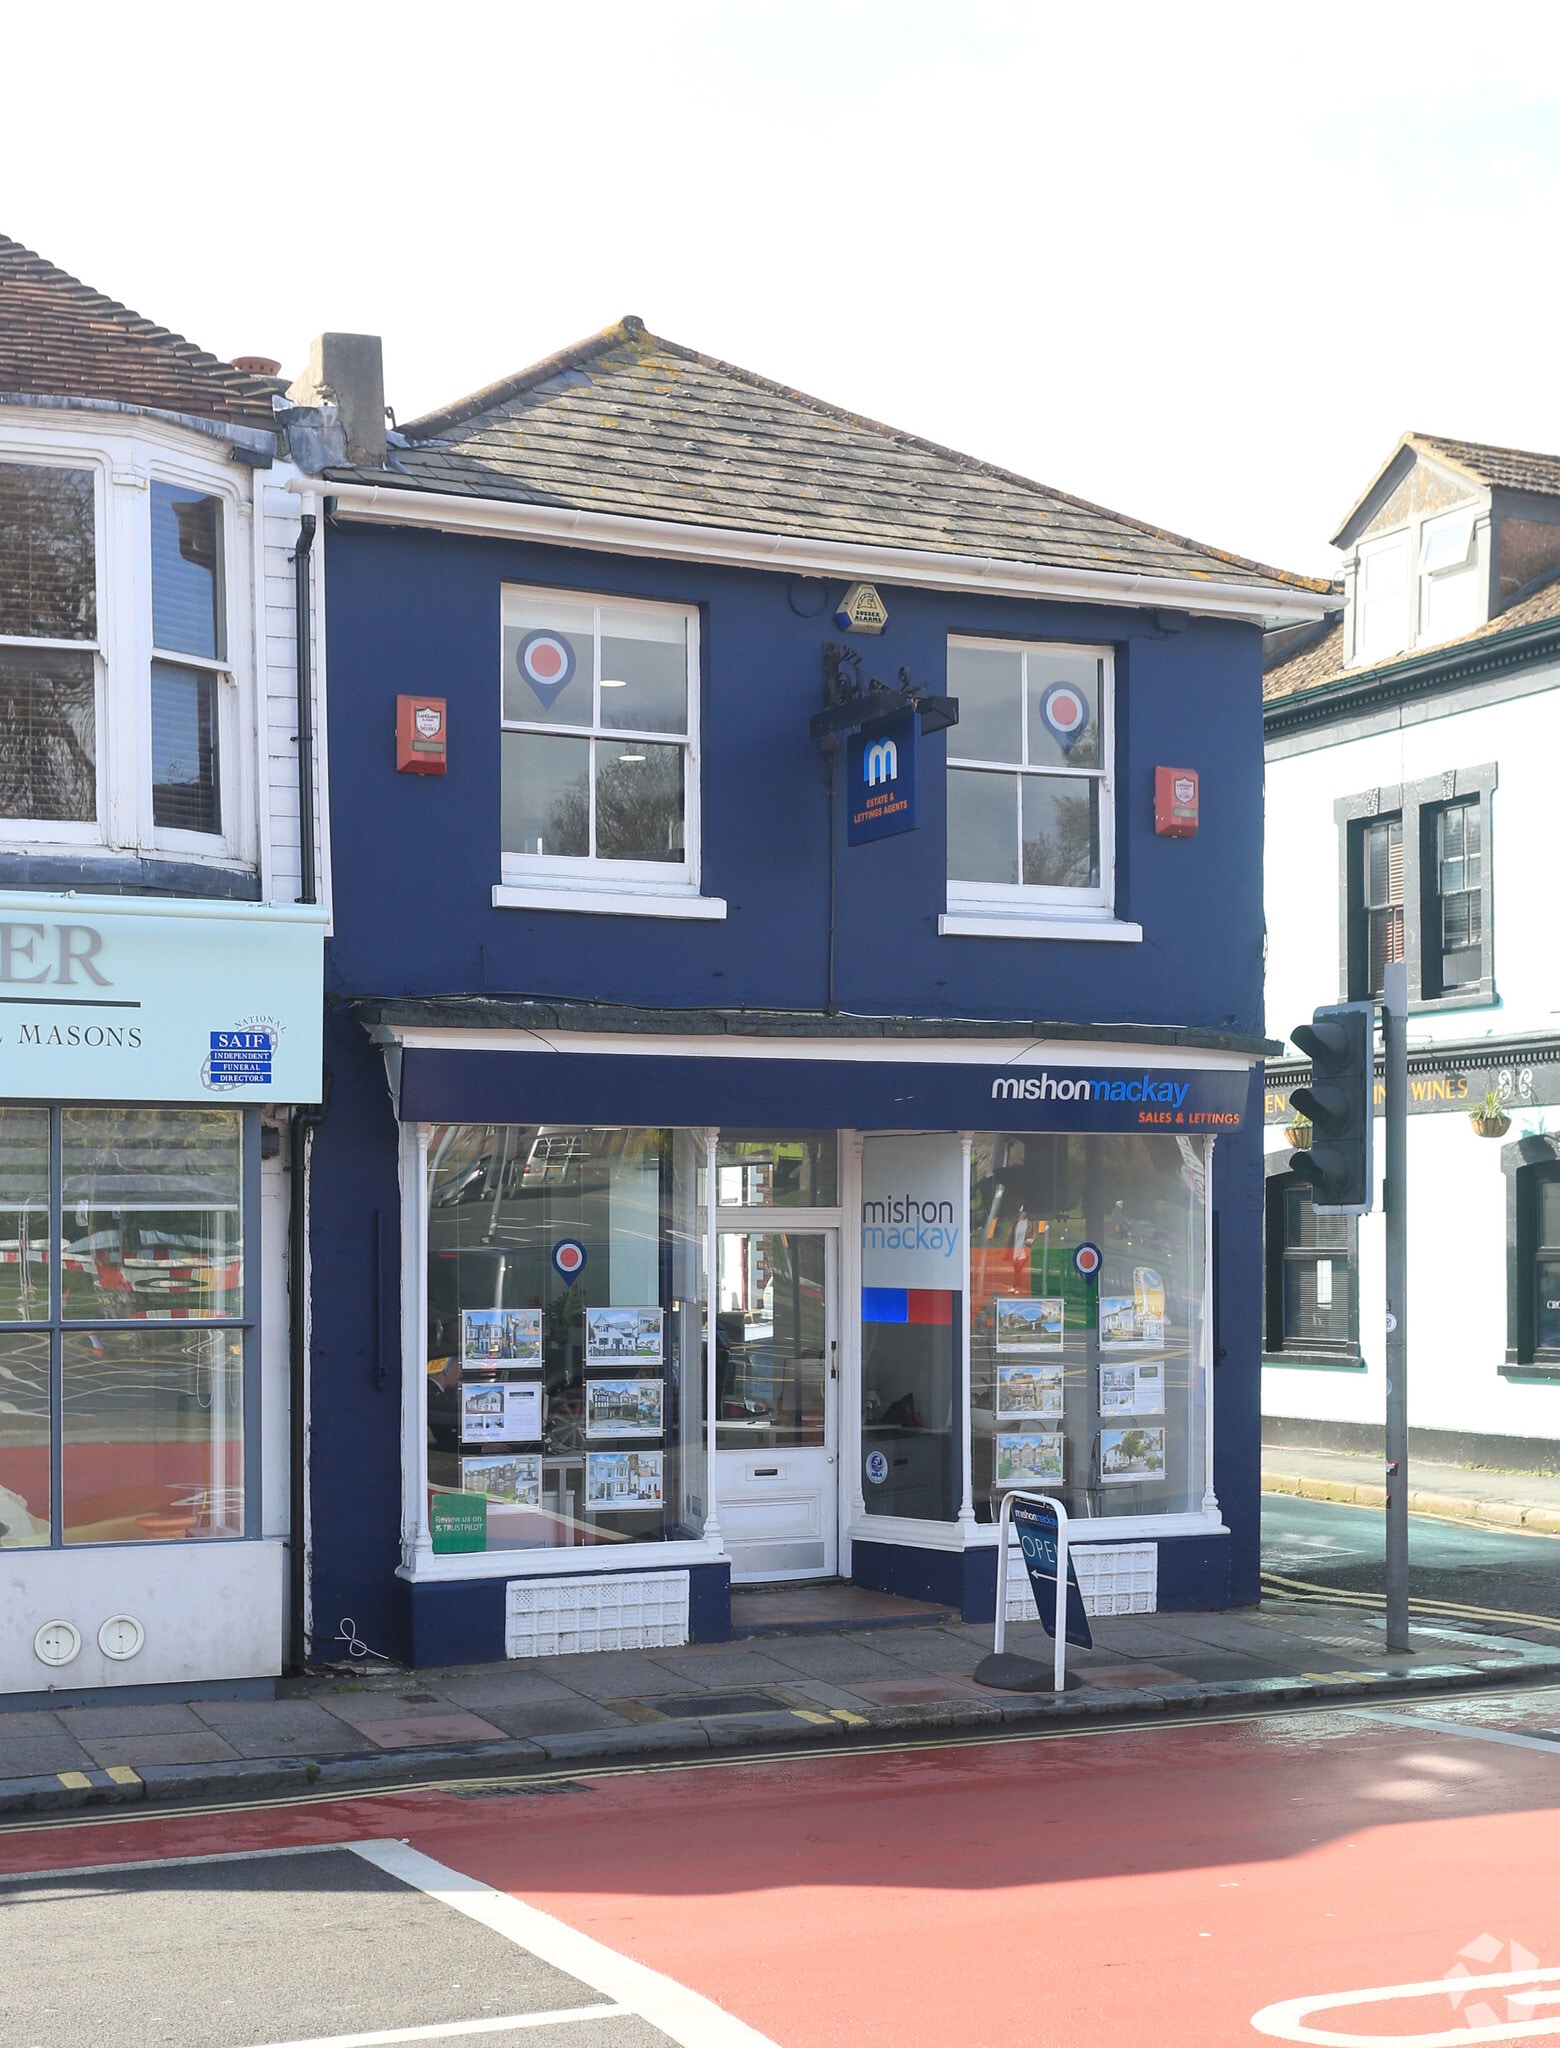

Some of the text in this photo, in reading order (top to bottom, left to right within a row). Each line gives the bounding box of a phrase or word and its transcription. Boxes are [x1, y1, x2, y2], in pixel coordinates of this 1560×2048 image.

[866, 792, 895, 809] ESTATE &
[853, 799, 908, 824] LETTINGS AGENTS
[0, 922, 114, 986] ER
[234, 1014, 288, 1034] NATIONAL
[17, 1024, 142, 1048] MASONS
[218, 1033, 265, 1048] SAIF
[214, 1052, 270, 1060] INDEPENDENT
[223, 1063, 261, 1071] FUNERAL
[220, 1074, 265, 1082] DIRECTORS
[991, 1073, 1190, 1108] mishonmackay
[1264, 1094, 1286, 1113] EN
[1411, 1078, 1468, 1102] WINES
[1138, 1111, 1240, 1125] SALES & LETTINGS
[863, 1194, 953, 1224] mishon
[862, 1215, 959, 1258] mackay
[435, 1515, 482, 1524] Review us on
